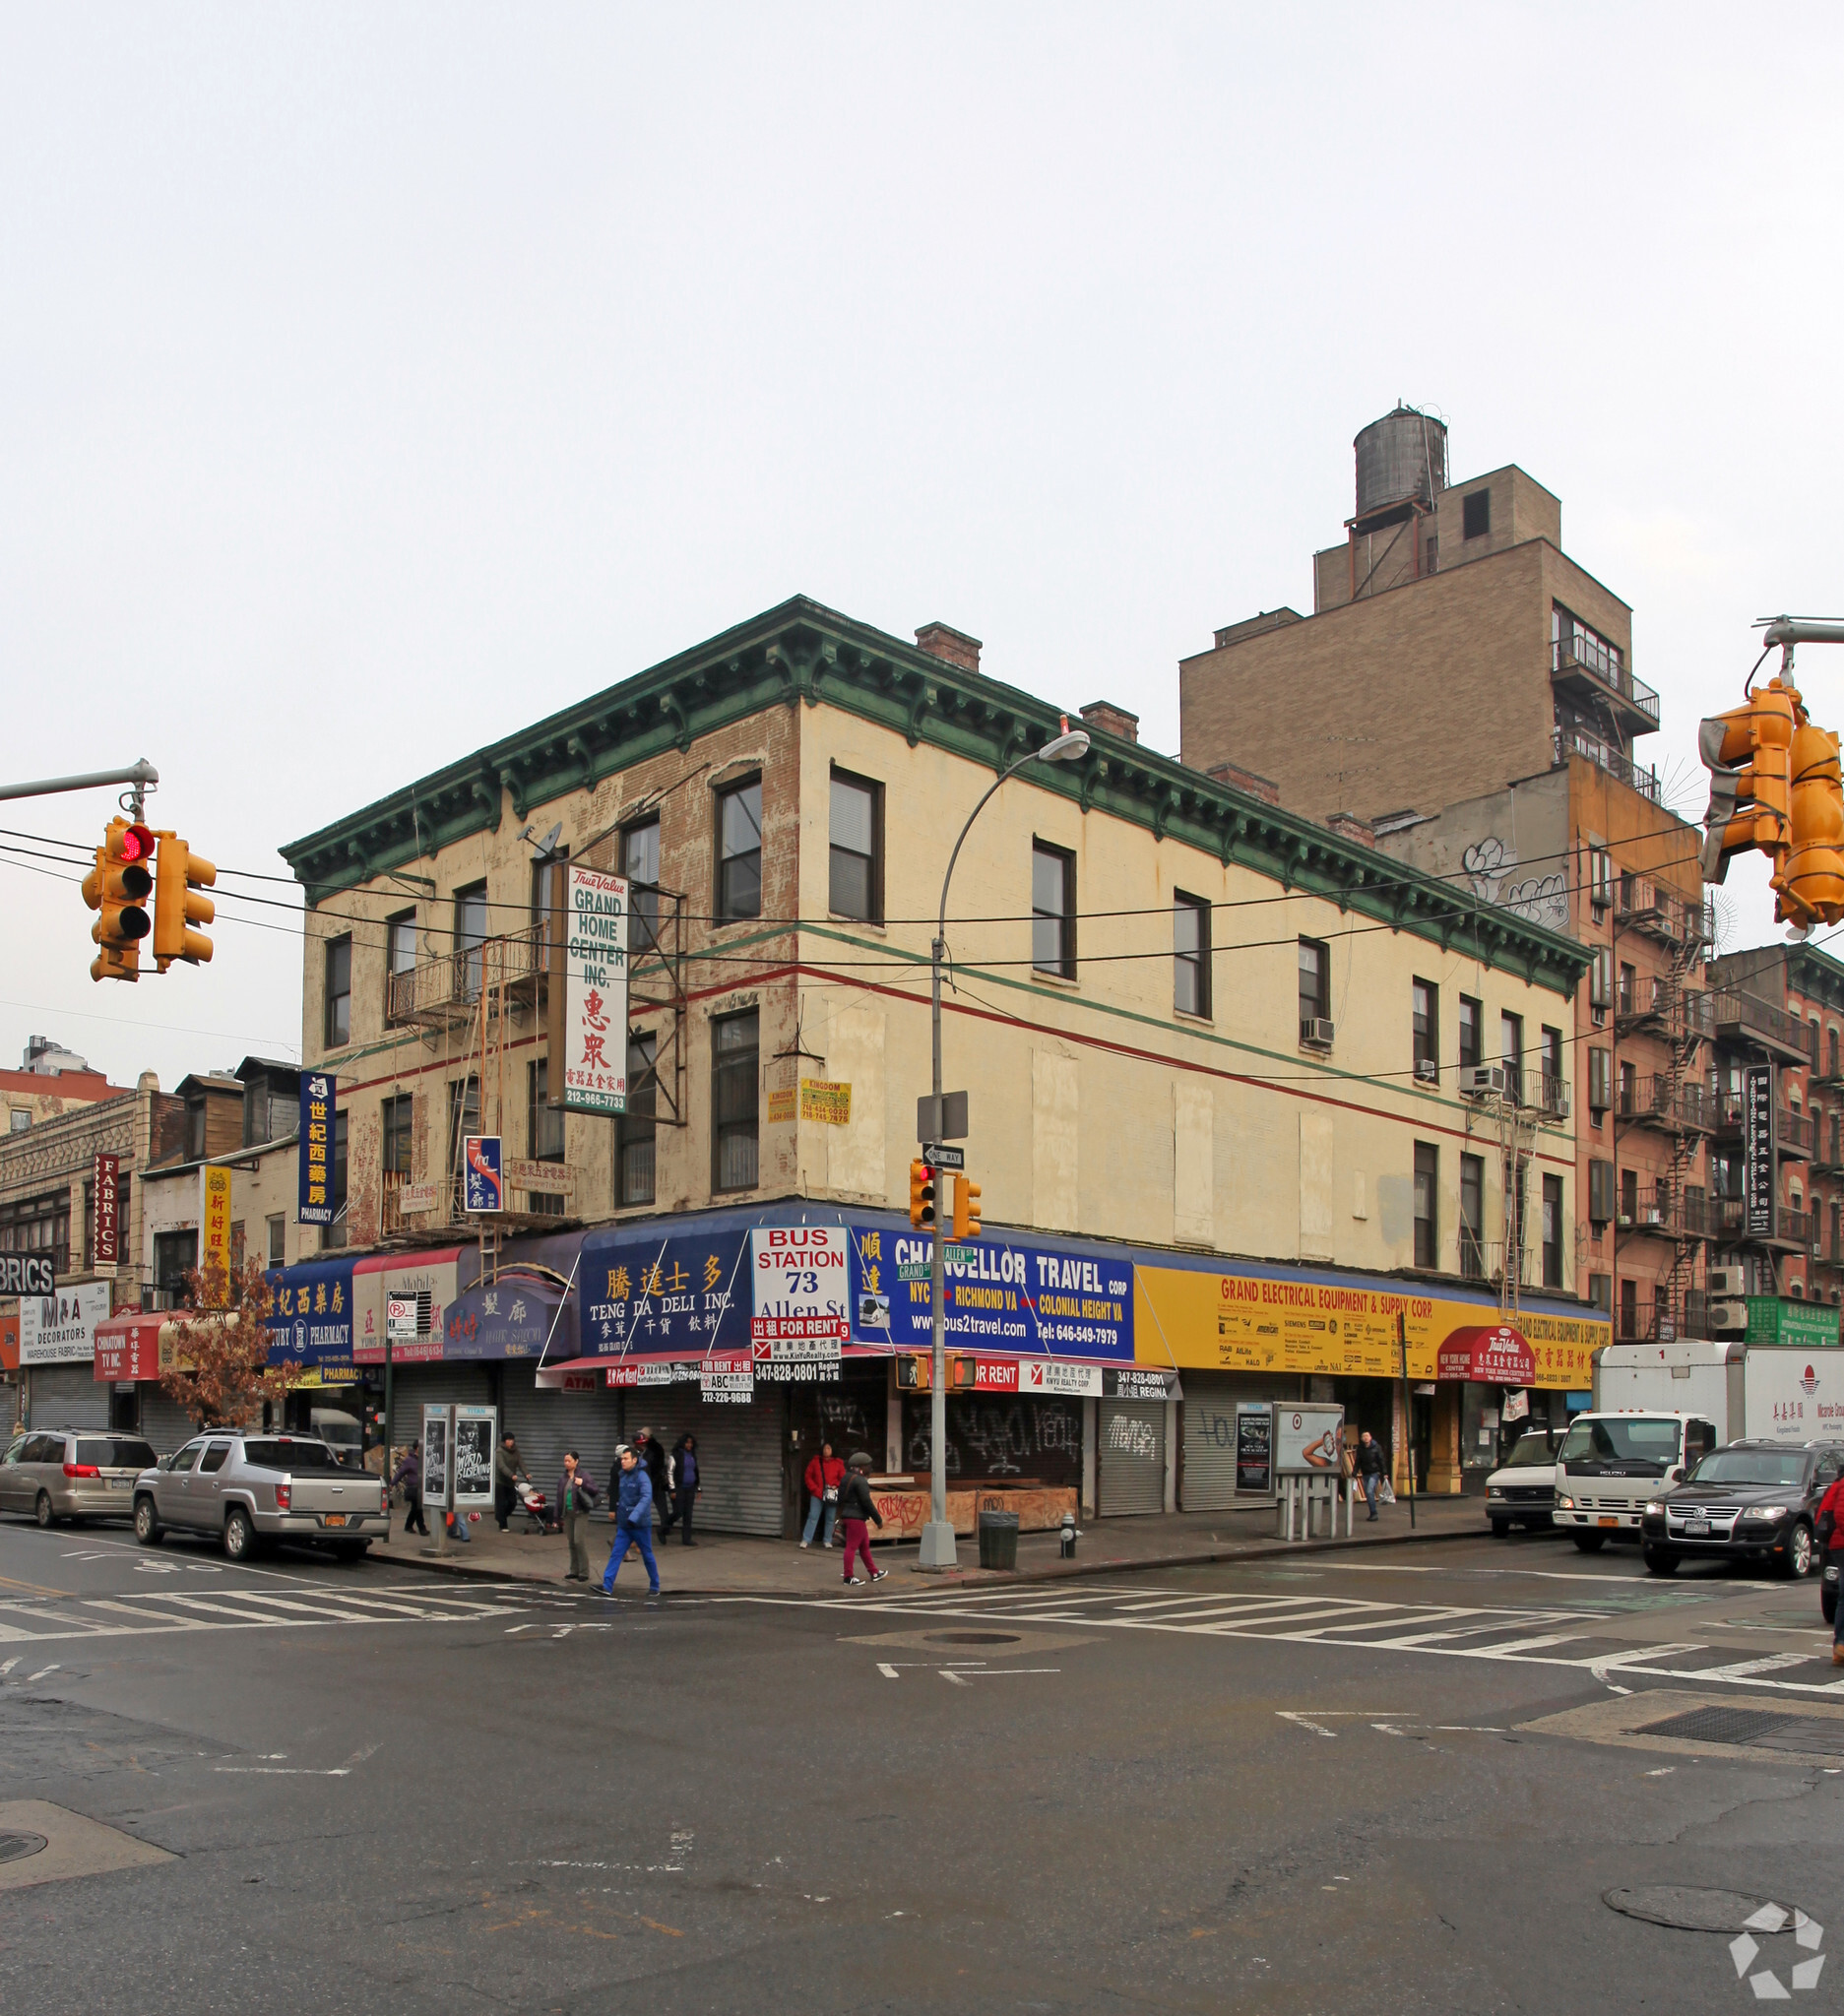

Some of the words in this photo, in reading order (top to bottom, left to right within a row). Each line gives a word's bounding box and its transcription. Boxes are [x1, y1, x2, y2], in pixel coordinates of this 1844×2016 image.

[573, 870, 596, 885] True
[593, 875, 624, 894] Value
[575, 889, 621, 916] GRAND
[579, 914, 617, 941] HOME
[570, 937, 623, 967] CENTER
[584, 964, 610, 988] INC.
[809, 1080, 840, 1091] KINGDOM
[567, 1091, 624, 1108] 212-966-7733
[309, 1102, 328, 1205] 世紀西藥房
[928, 1150, 941, 1161] ONE
[946, 1153, 959, 1162] WAY
[101, 1161, 115, 1255] FABRICS
[301, 1207, 332, 1222] PHARMACY
[769, 1229, 828, 1246] BUS
[758, 1251, 844, 1268] STATION
[860, 1231, 883, 1294] 順達
[945, 1248, 965, 1261] ALLEN
[899, 1264, 923, 1279] GRAND
[1037, 1256, 1103, 1293] TRAVEL
[1109, 1280, 1127, 1295] CORP
[786, 1272, 818, 1293] 73
[590, 1301, 625, 1321] TENG
[633, 1300, 653, 1317] DA
[662, 1294, 695, 1313] DELI
[704, 1292, 734, 1310] INC.
[910, 1282, 930, 1303] NYC
[955, 1286, 1004, 1310] RICHMOND
[1005, 1291, 1017, 1311] VA
[1039, 1294, 1081, 1318] COLONIAL
[1082, 1298, 1112, 1321] HEIGHT
[1113, 1302, 1122, 1322] VA
[1222, 1279, 1258, 1301] GRAND
[1262, 1283, 1315, 1307] ELECTRICAL
[1318, 1289, 1367, 1312] EQUIPMENT
[1371, 1295, 1376, 1313] &
[1380, 1295, 1408, 1317] SUPPLY
[1411, 1299, 1432, 1319] CORP.
[41, 1296, 57, 1328] M
[60, 1298, 68, 1324] &
[72, 1298, 81, 1320] A
[761, 1300, 818, 1318] Allen
[826, 1299, 846, 1319] St
[37, 1327, 86, 1345] DECORATORS
[310, 1325, 350, 1345] PHARMACY
[754, 1320, 778, 1337] 出租
[780, 1320, 804, 1336] FOR
[806, 1318, 838, 1335] RENT
[1037, 1322, 1054, 1340] Tel:
[1055, 1326, 1117, 1346] 646-549-7979
[97, 1335, 126, 1350] CHINATOWN
[361, 1337, 377, 1347] YUNG
[27, 1349, 56, 1358] WAREHOUSE
[101, 1354, 110, 1367] TV
[1449, 1354, 1458, 1364] YORK
[1459, 1354, 1470, 1364] HOME
[1659, 1350, 1665, 1359] 1
[324, 1367, 363, 1380] PHARMACY
[702, 1360, 713, 1371] FOR
[714, 1360, 731, 1371] RENT
[755, 1364, 817, 1382] 347-828-0801
[563, 1376, 596, 1389] ATM
[712, 1375, 729, 1388] ABC
[989, 1366, 1016, 1383] RENT
[1117, 1371, 1164, 1385] 347-828-0801
[702, 1392, 751, 1403] 212-226-9688
[1140, 1387, 1168, 1398] REGINA
